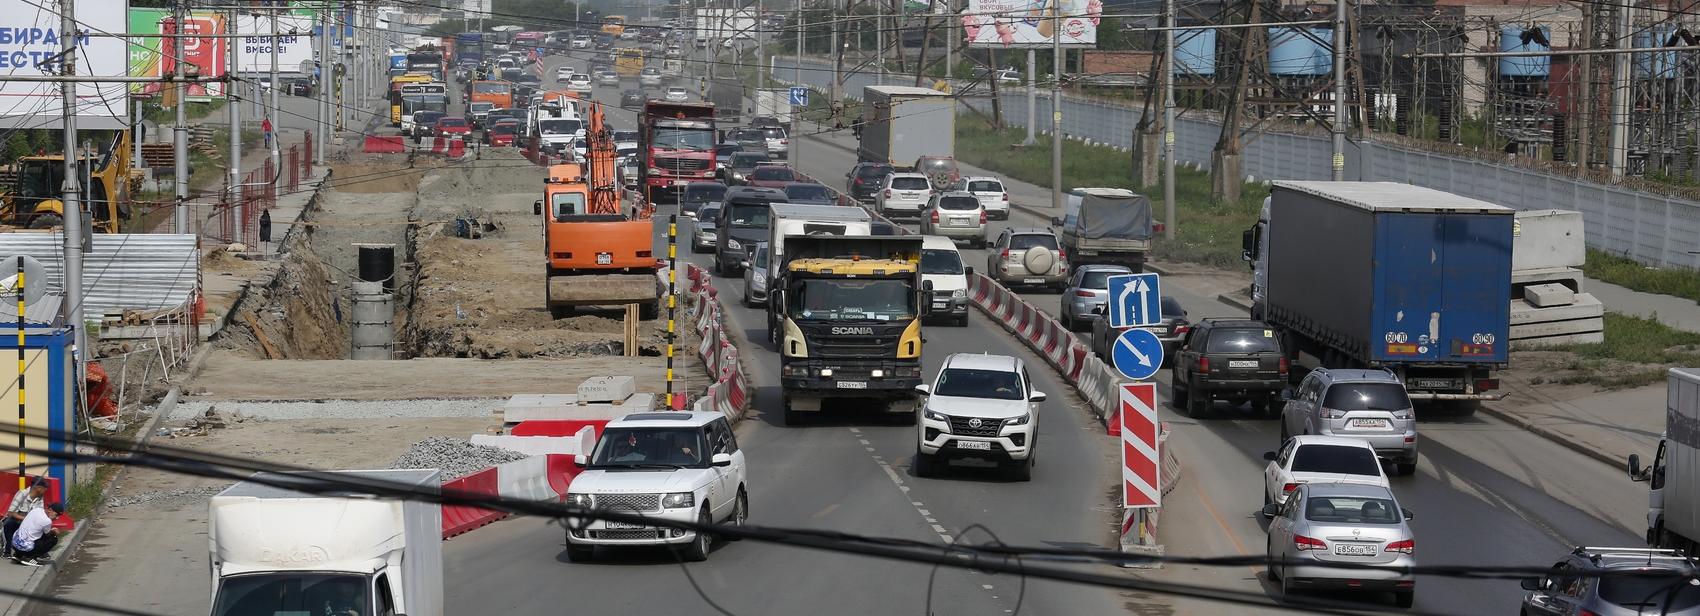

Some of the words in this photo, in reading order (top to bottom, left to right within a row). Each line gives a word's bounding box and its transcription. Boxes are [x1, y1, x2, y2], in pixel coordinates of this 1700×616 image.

[0, 28, 90, 46] БИРАМ
[245, 36, 298, 44] ВЫБИАЕМ
[245, 46, 287, 54] ВМЕСЕ!
[831, 326, 874, 335] SCANIA
[1386, 332, 1396, 343] 60
